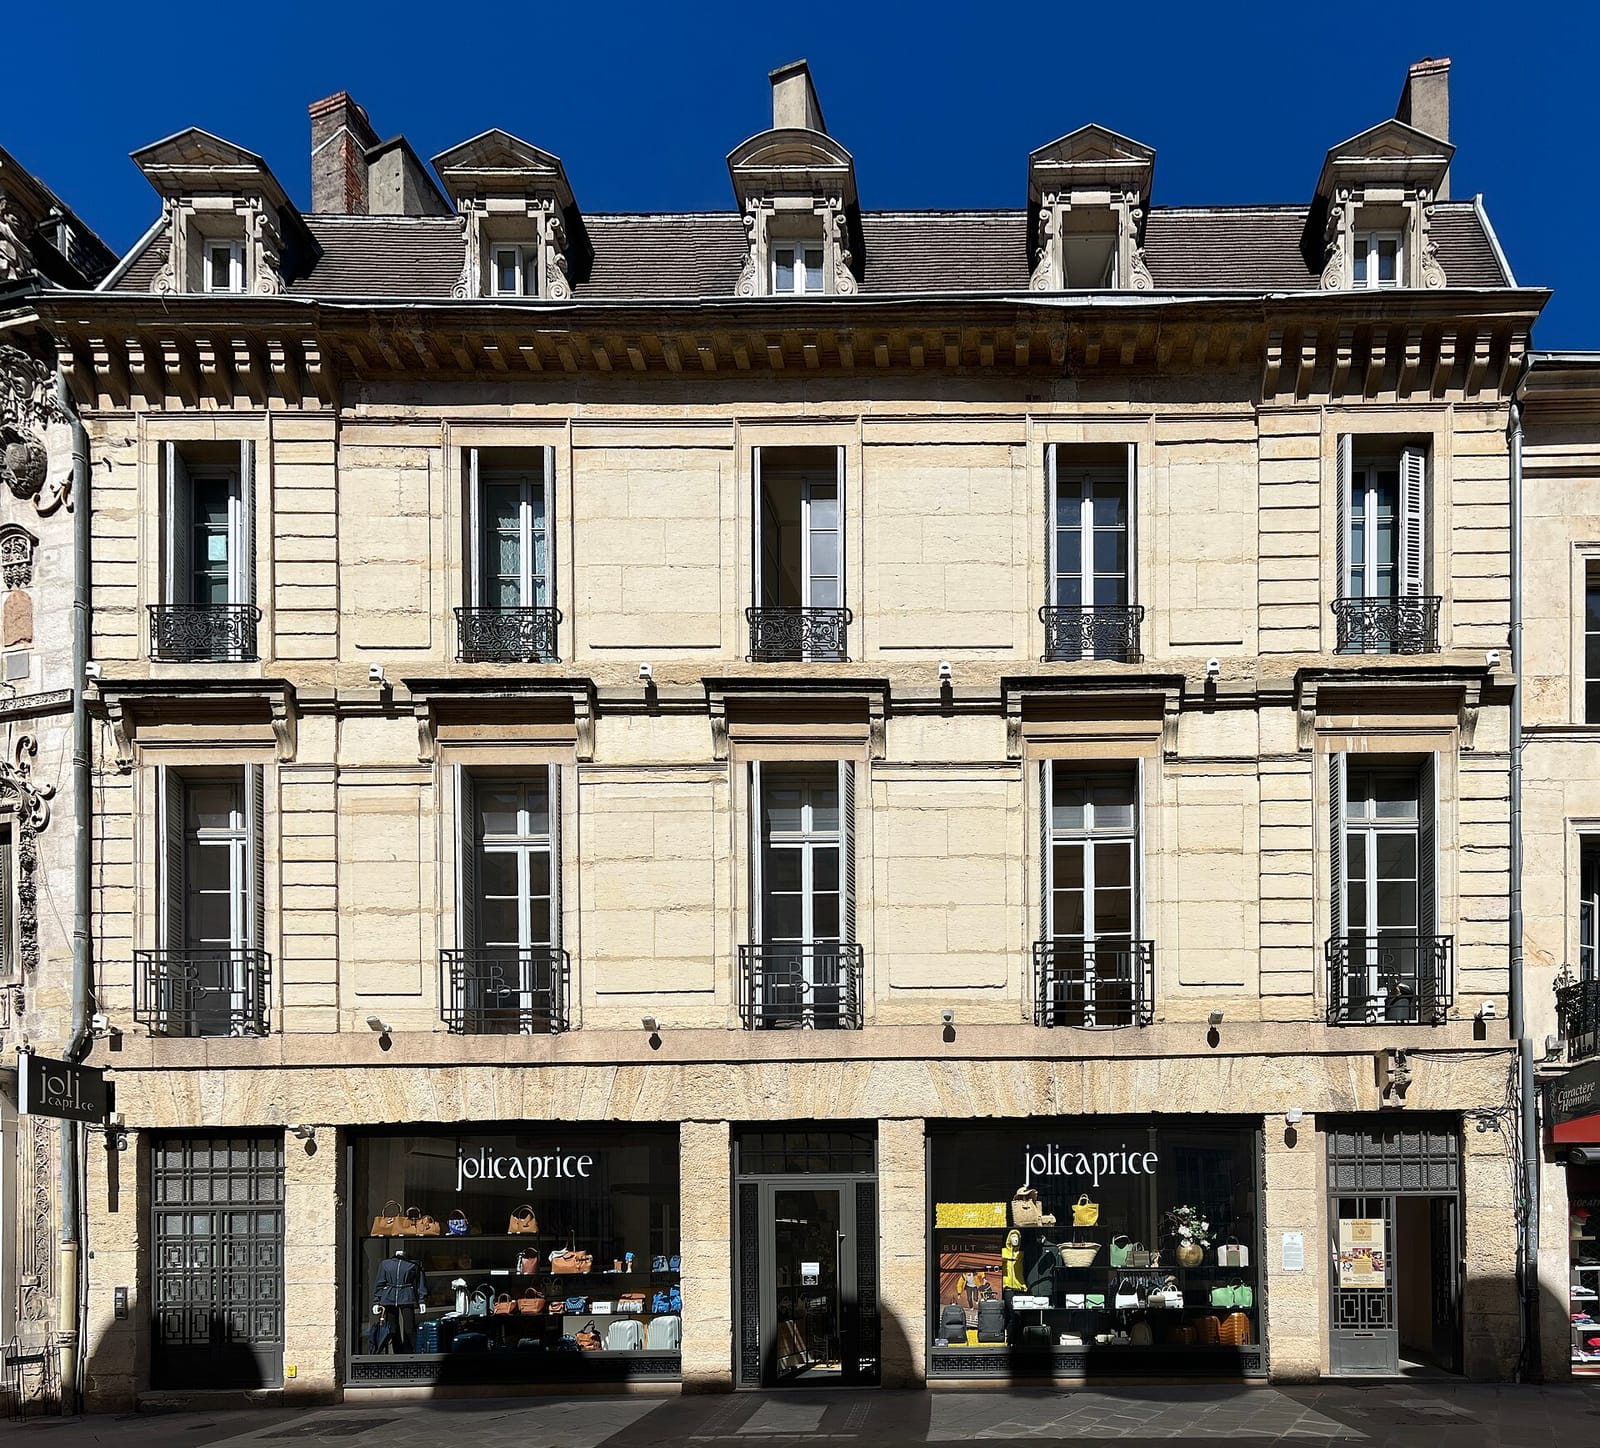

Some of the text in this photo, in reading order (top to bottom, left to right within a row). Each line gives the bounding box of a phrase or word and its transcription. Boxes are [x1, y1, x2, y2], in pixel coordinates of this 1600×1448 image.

[40, 1065, 80, 1110] joli
[1558, 1082, 1596, 1104] Caractère
[455, 1146, 593, 1192] jolicaprice
[1023, 1143, 1159, 1188] jolicaprice
[943, 1244, 978, 1252] BUILT
